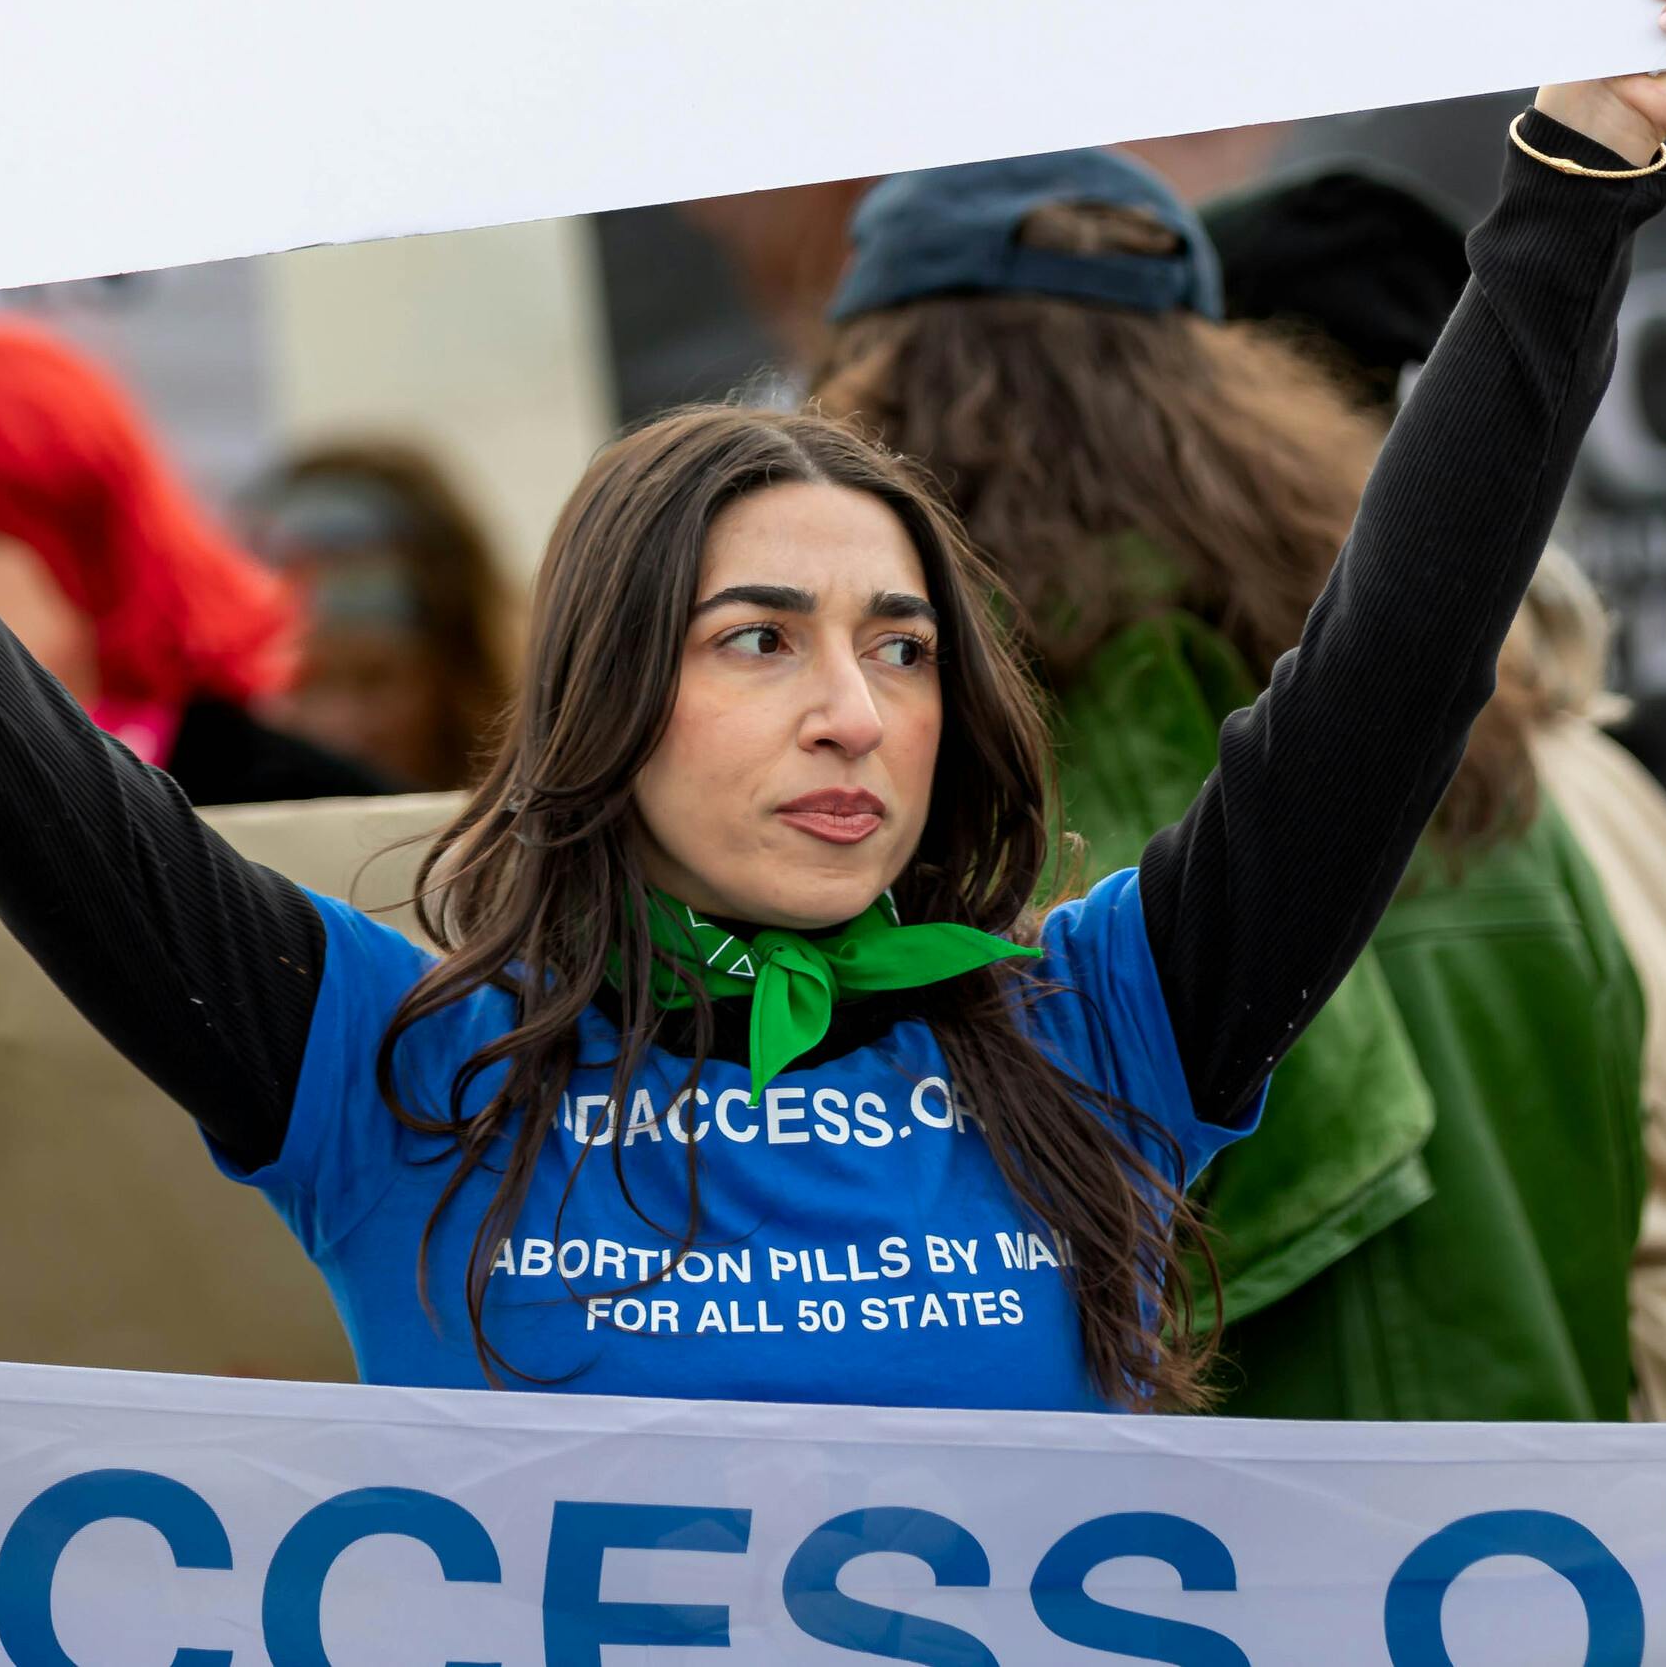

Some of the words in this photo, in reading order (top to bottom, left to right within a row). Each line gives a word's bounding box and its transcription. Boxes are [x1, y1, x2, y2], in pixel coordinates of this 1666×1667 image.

[490, 1237, 752, 1284] ABORTION
[768, 1236, 912, 1283] PILLS
[925, 1234, 979, 1275] BY
[586, 1297, 680, 1333] FOR
[696, 1299, 785, 1333] ALL
[797, 1298, 847, 1333] 50
[860, 1288, 1025, 1331] STATES
